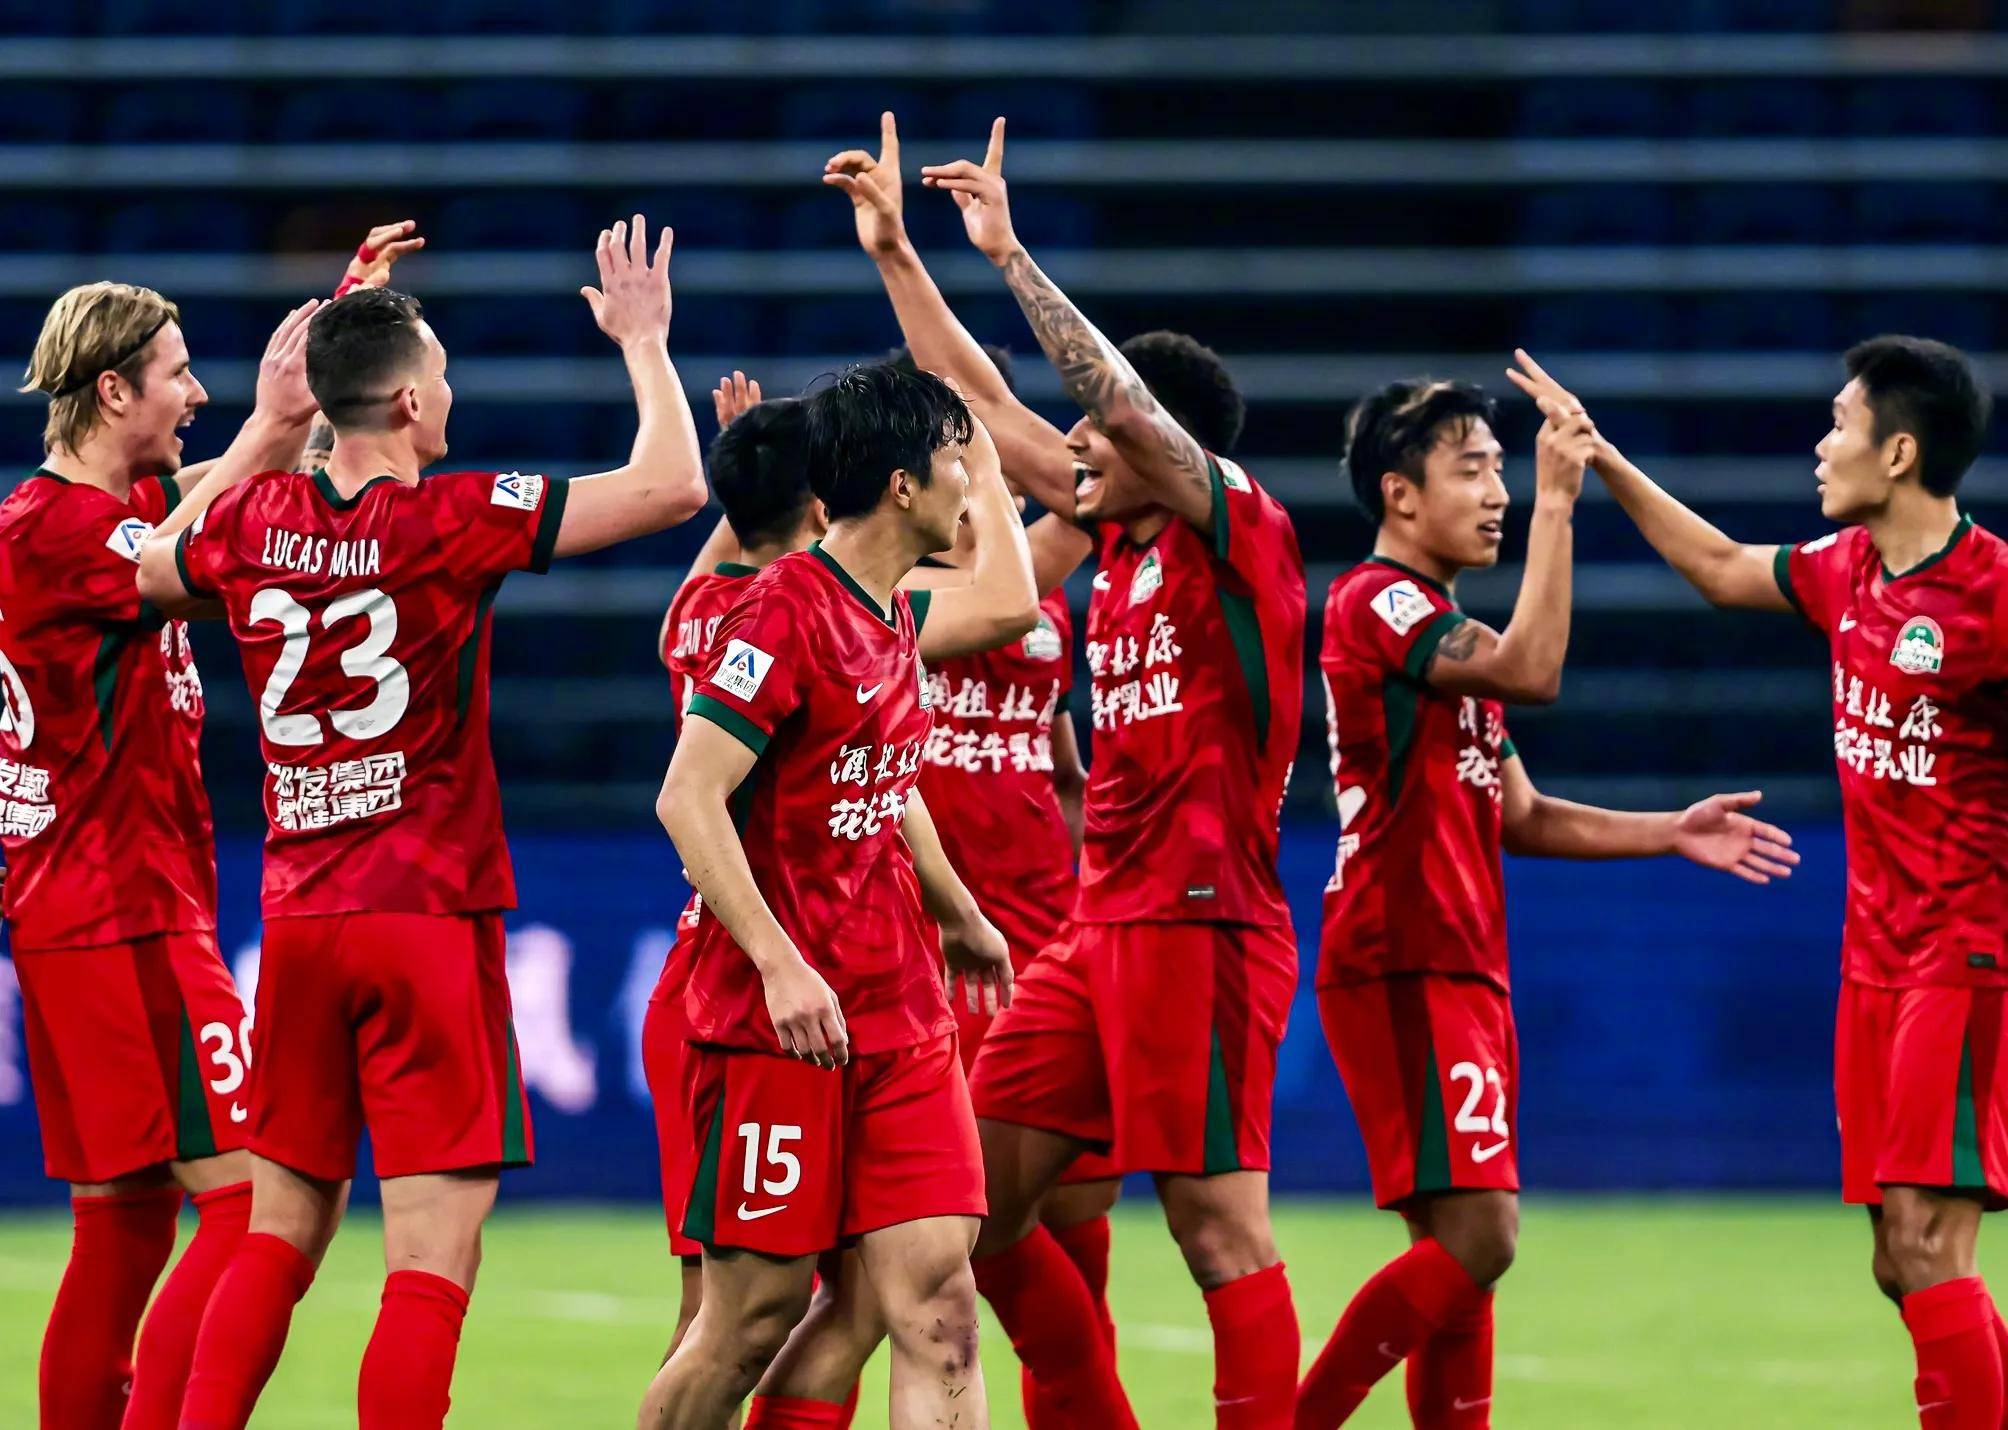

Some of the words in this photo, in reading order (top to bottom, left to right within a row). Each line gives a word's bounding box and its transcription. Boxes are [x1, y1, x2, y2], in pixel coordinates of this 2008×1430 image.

[262, 527, 327, 575] LUCAS
[328, 538, 381, 578] MAIA
[249, 588, 411, 747] 23
[738, 1122, 802, 1196] 15
